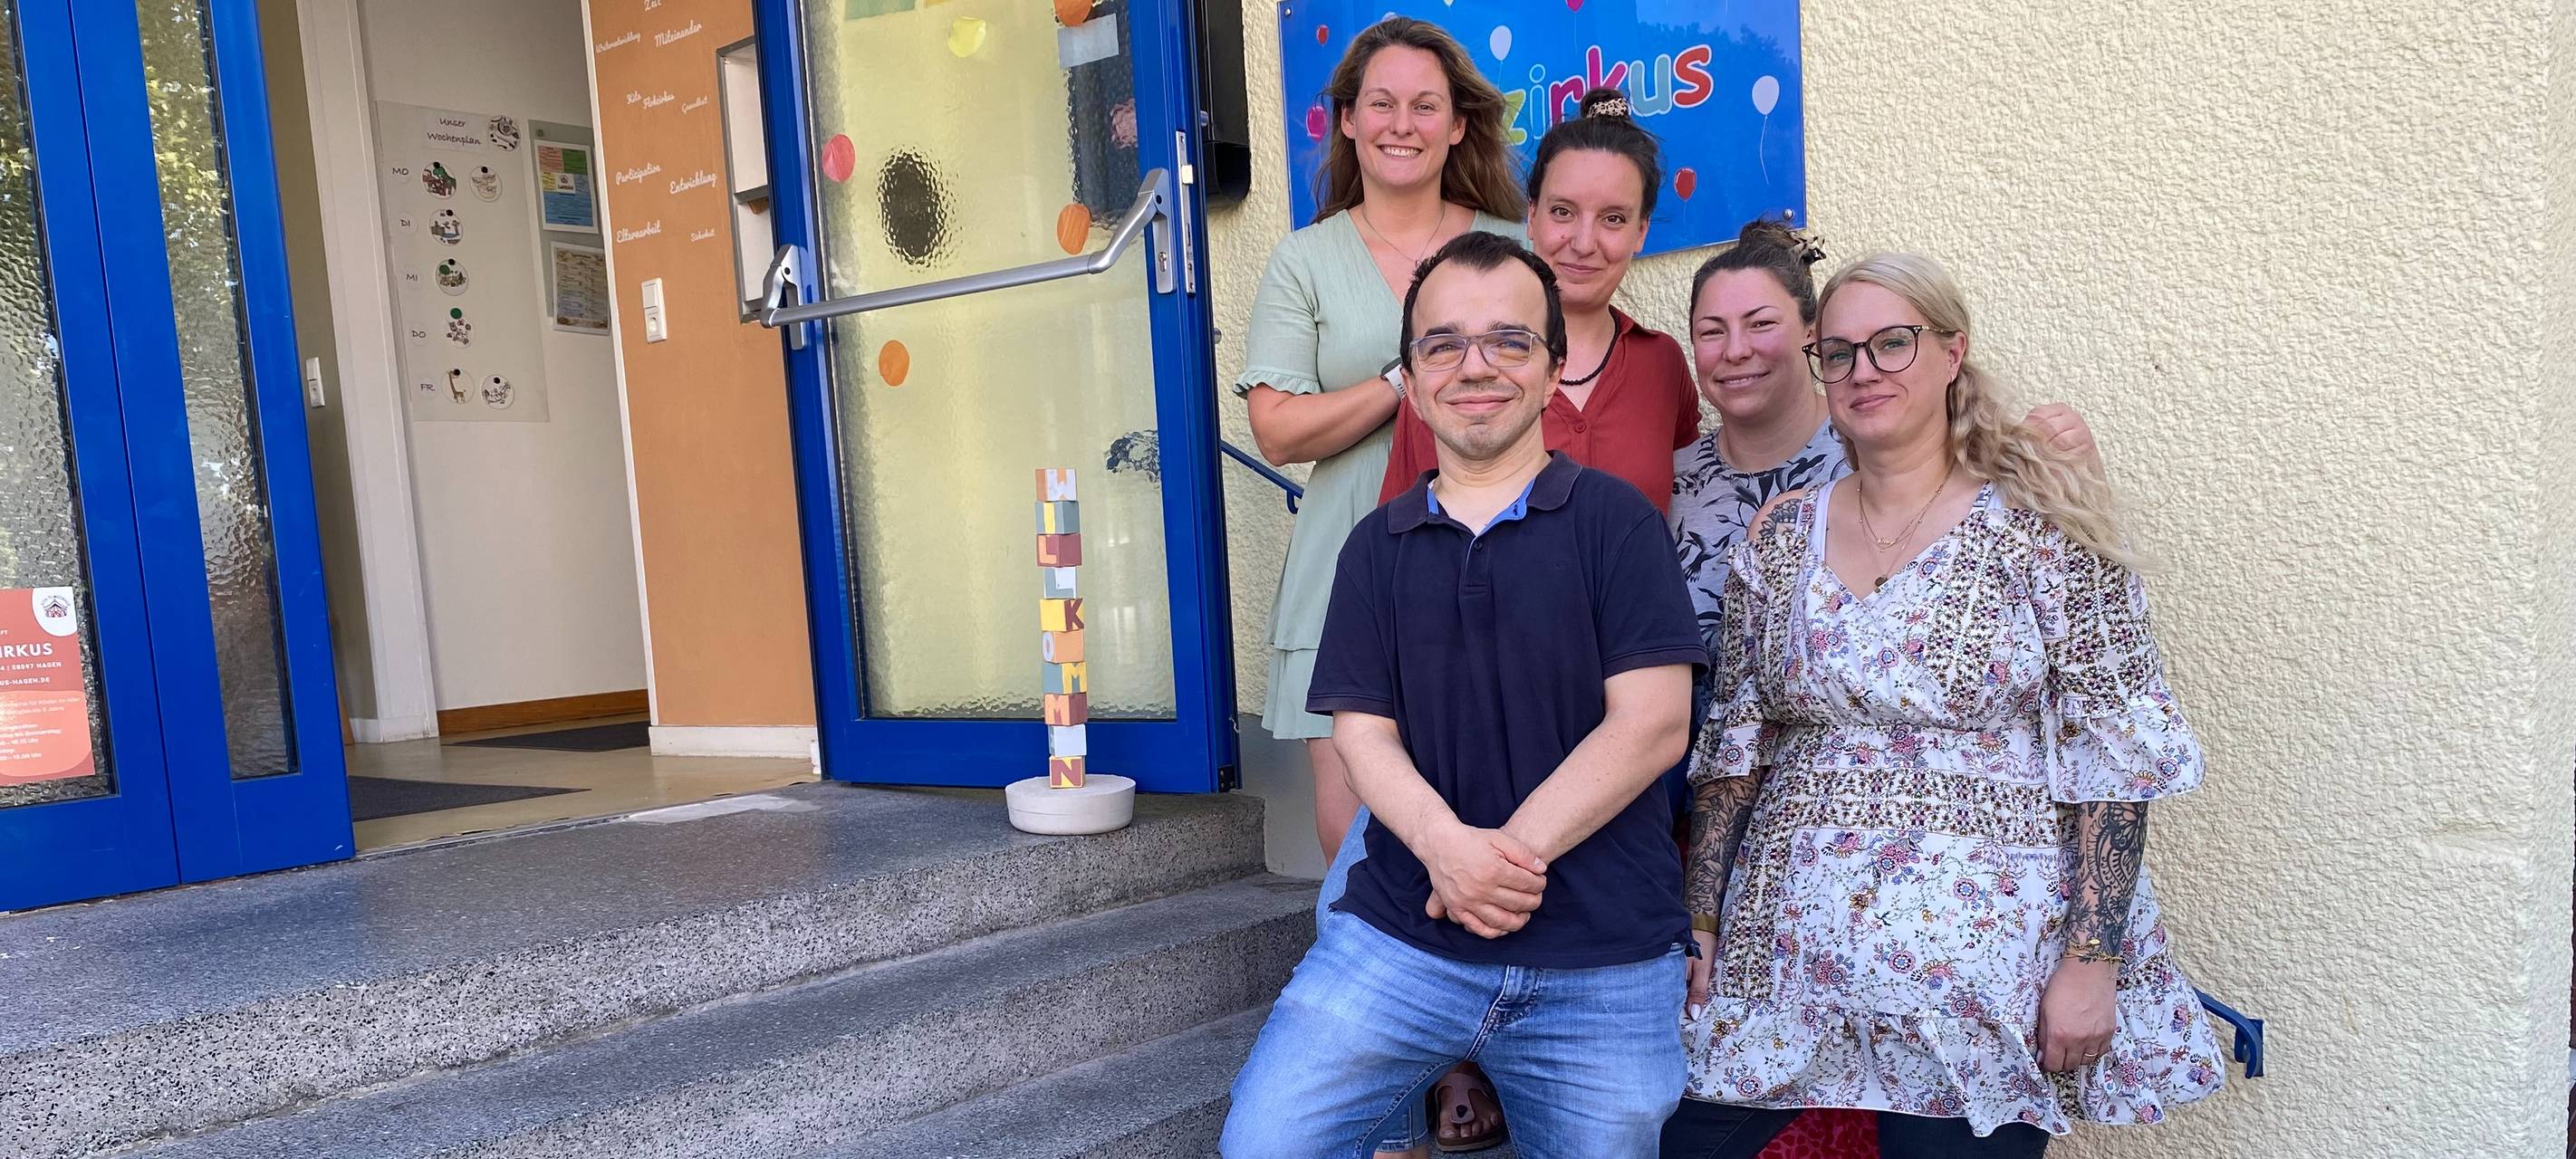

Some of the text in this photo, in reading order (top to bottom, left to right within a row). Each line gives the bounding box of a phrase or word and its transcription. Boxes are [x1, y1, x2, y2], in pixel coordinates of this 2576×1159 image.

[439, 118, 466, 128] Unser
[427, 132, 481, 147] Wochenplan
[392, 167, 409, 176] MO
[669, 169, 717, 195] Entwicklung
[399, 219, 411, 227] DI
[406, 274, 418, 283] MI
[411, 330, 427, 339] DO
[420, 383, 436, 392] FR
[36, 661, 62, 669] HAGEN
